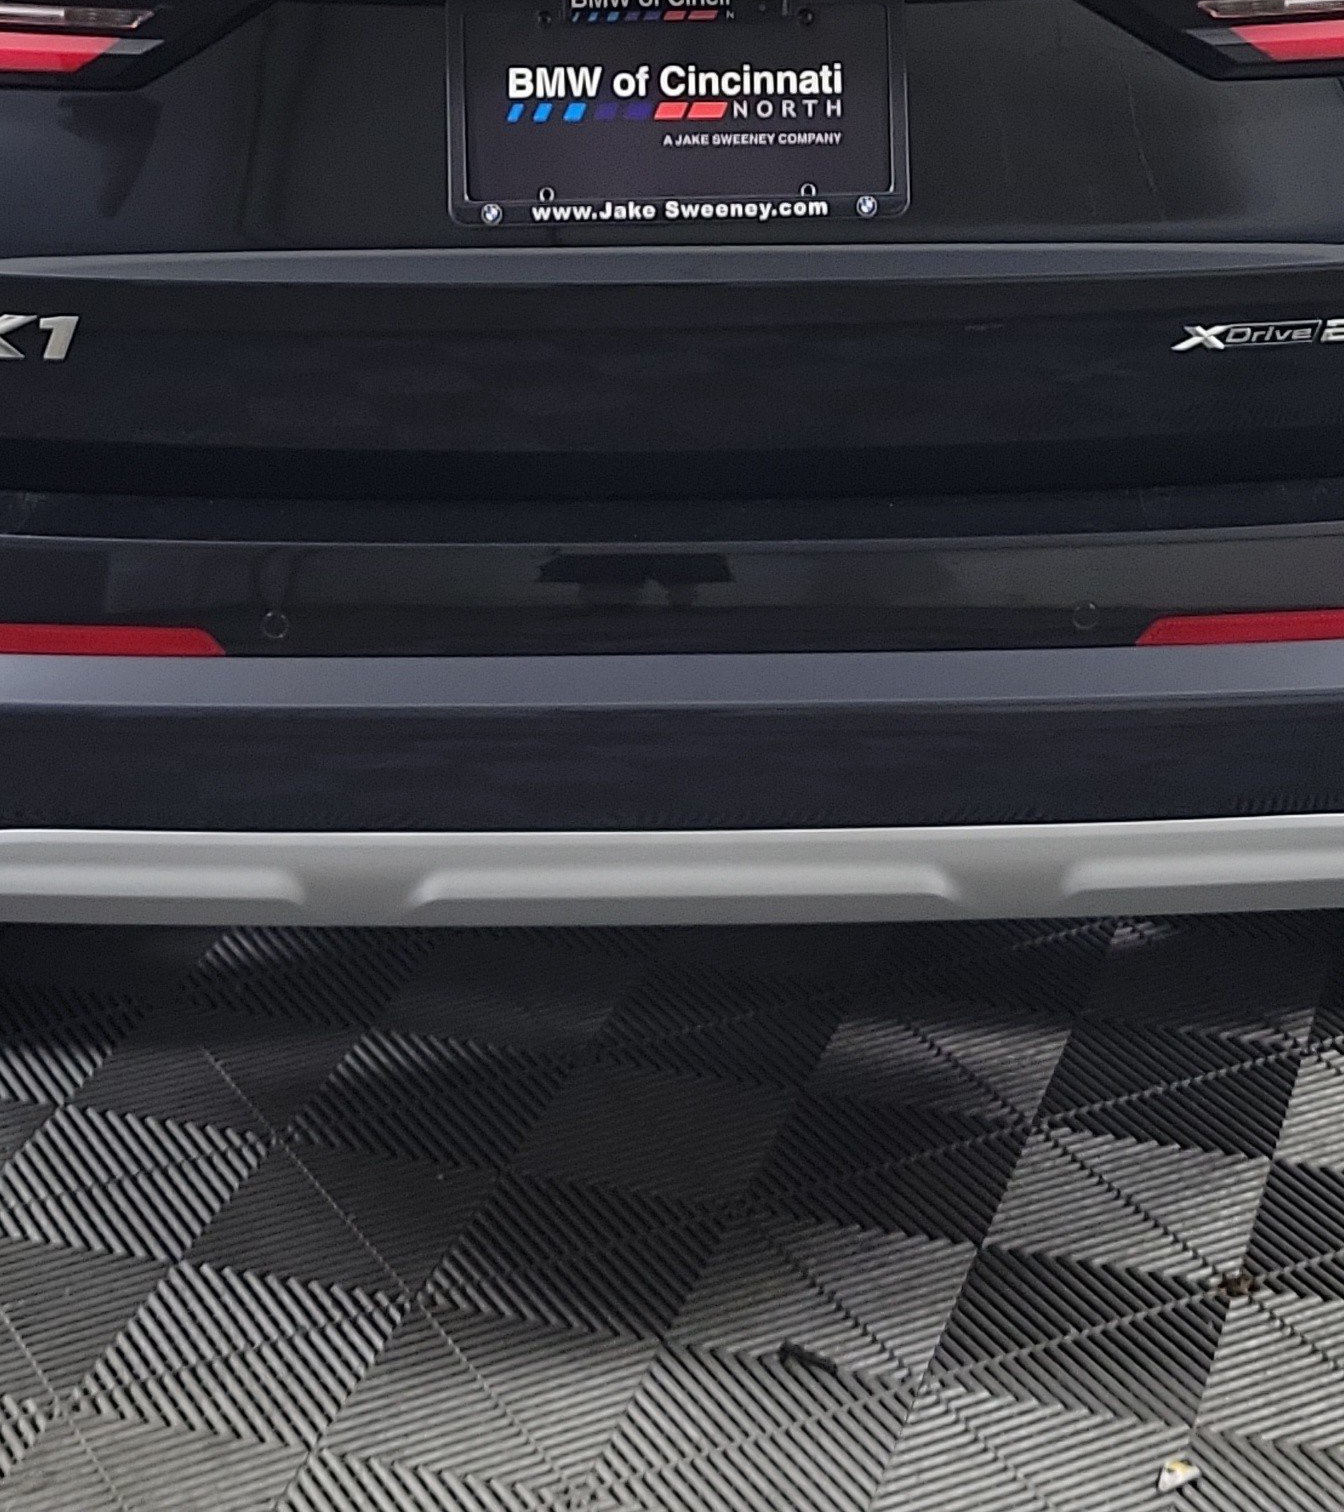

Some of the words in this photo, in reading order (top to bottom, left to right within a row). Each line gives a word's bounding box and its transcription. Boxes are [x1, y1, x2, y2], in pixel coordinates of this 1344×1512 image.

[508, 66, 602, 98] BMW
[613, 65, 649, 96] of
[659, 63, 842, 96] Cincinnati
[732, 99, 842, 118] NORTH
[663, 135, 673, 146] A
[675, 134, 710, 146] JAKE
[712, 133, 775, 145] SWEENEY
[778, 132, 842, 144] COMPANY
[532, 201, 656, 221] www.Jake
[665, 199, 828, 220] Sweeney.com
